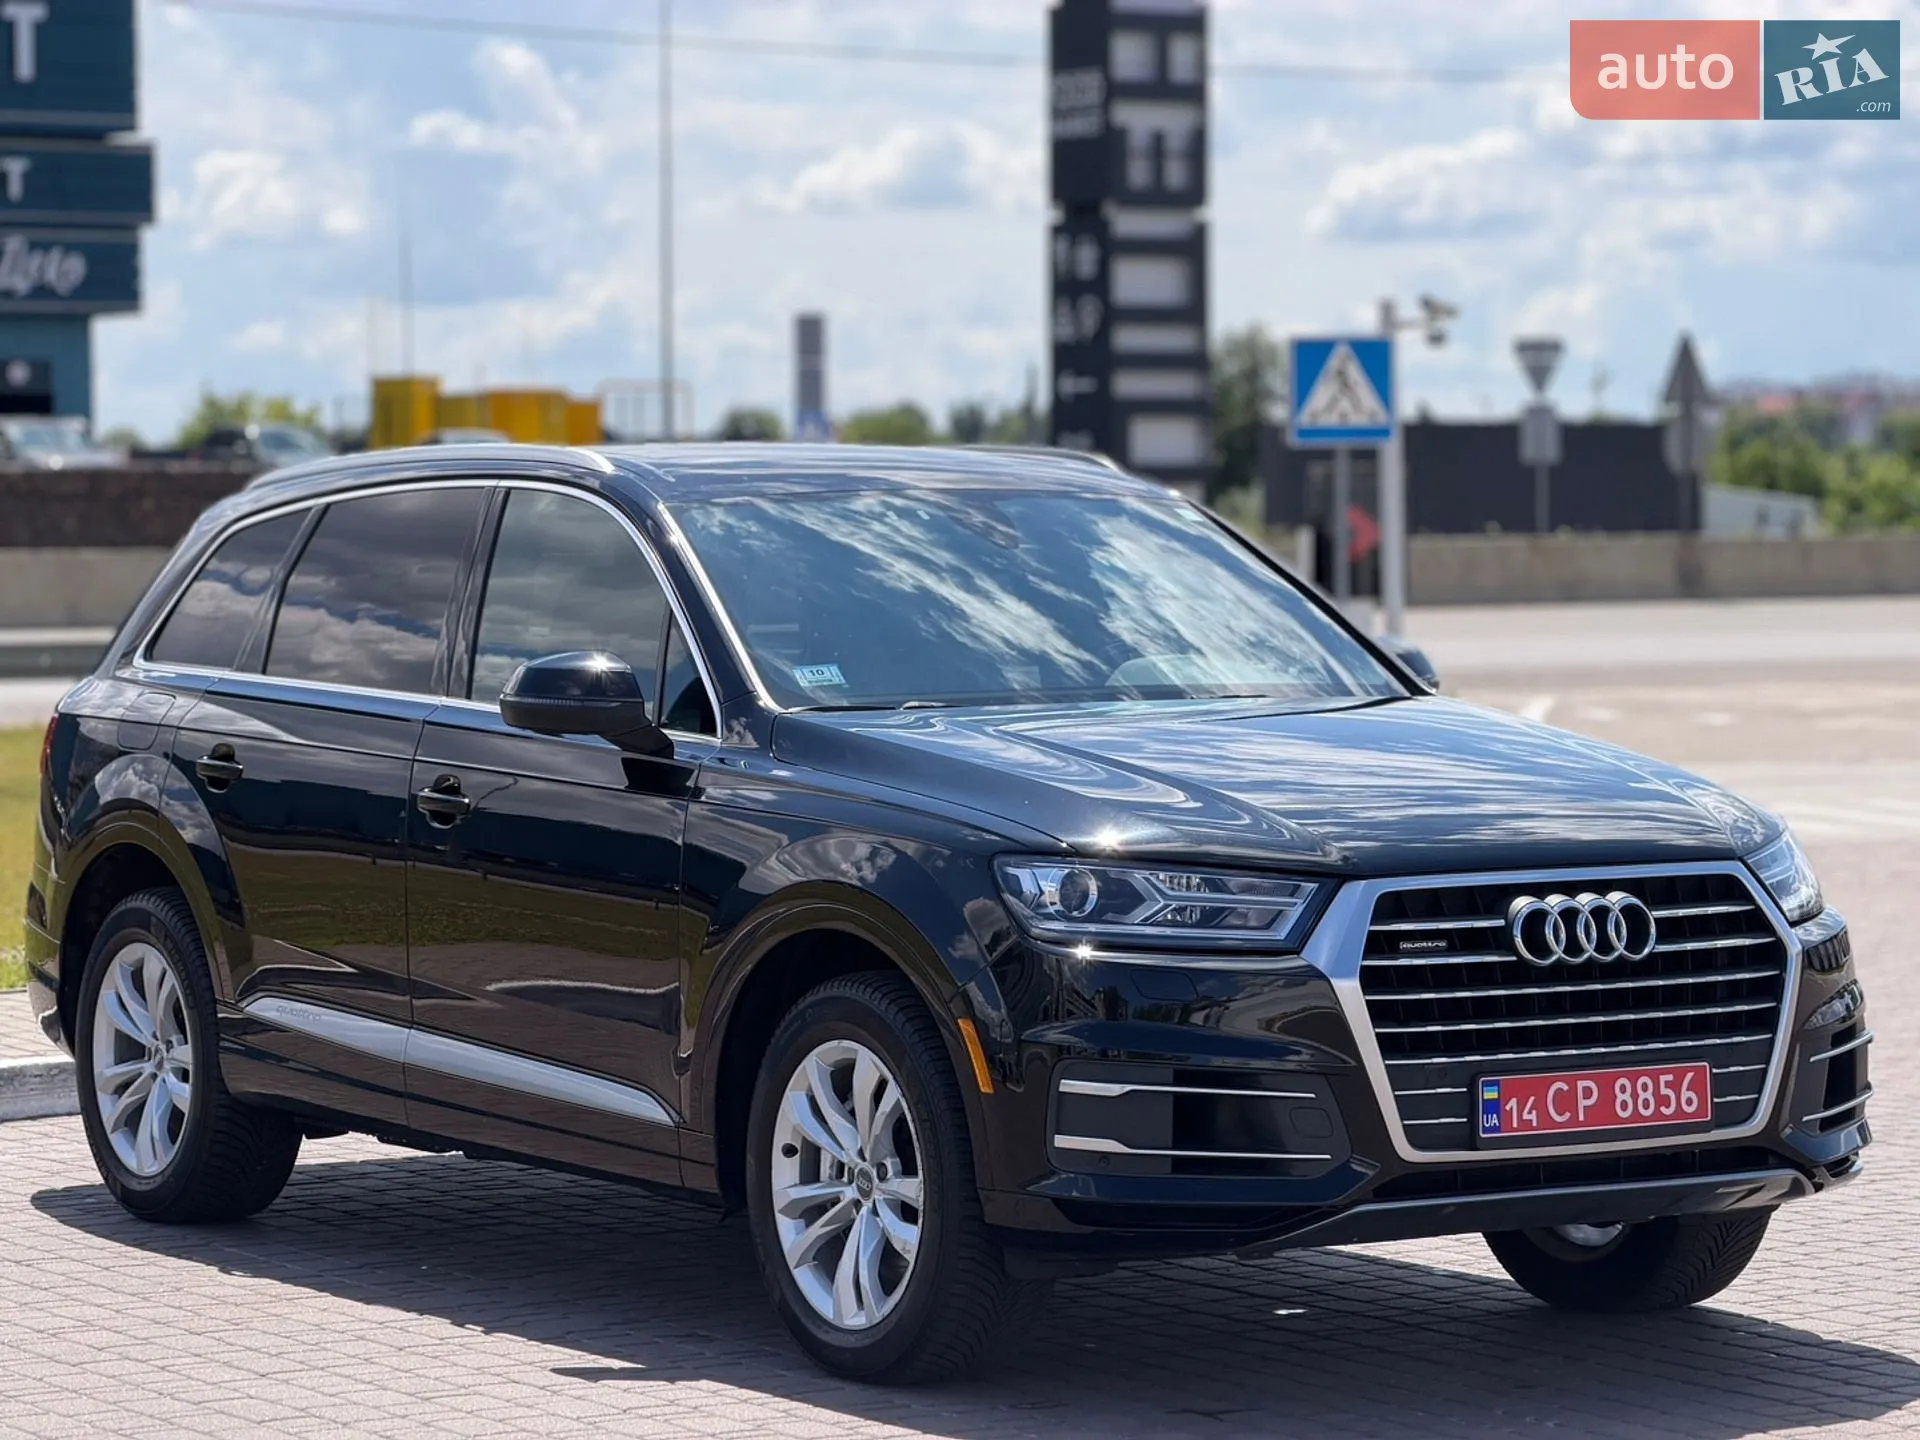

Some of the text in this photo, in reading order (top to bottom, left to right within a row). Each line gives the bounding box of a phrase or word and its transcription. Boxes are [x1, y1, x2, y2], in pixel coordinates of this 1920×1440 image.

[808, 669, 825, 677] 10
[1504, 1071, 1699, 1128] 14 CP 8856
[1482, 1113, 1500, 1127] UA
